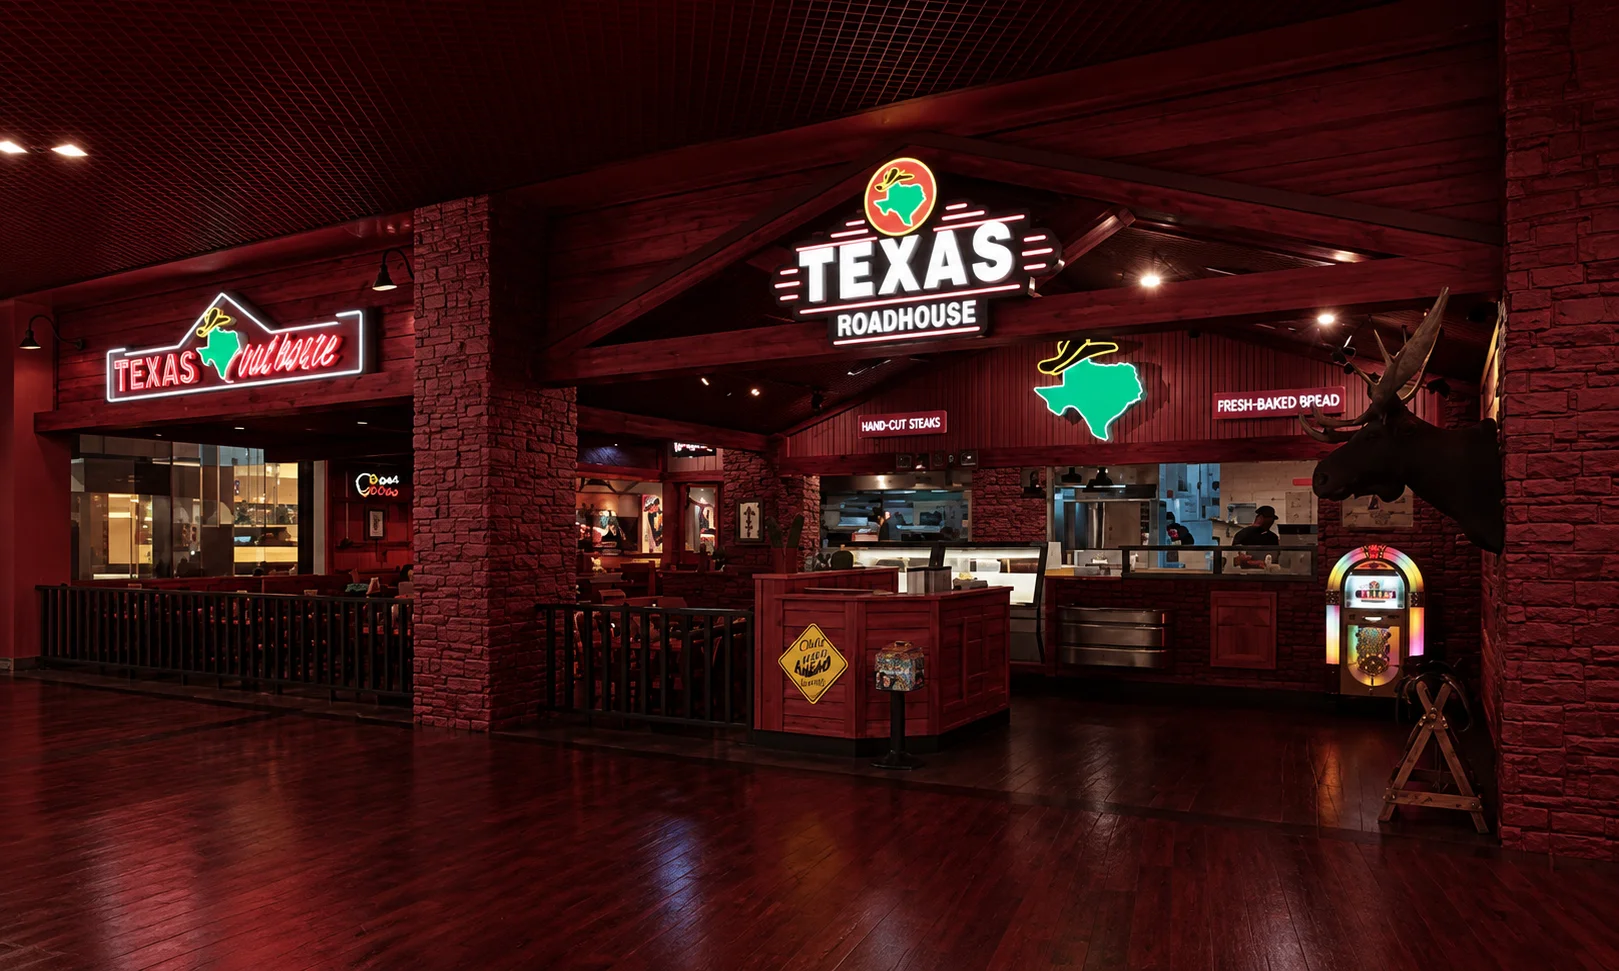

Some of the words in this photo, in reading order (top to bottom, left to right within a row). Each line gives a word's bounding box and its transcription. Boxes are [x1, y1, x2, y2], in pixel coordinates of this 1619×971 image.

[799, 221, 1016, 303] TEXAS
[837, 300, 977, 337] ROADHOUSE
[113, 351, 199, 392] TEXAS
[1217, 395, 1297, 412] FRESH-BAKED
[861, 418, 907, 432] HAND-CUT
[908, 417, 941, 430] STEAKS
